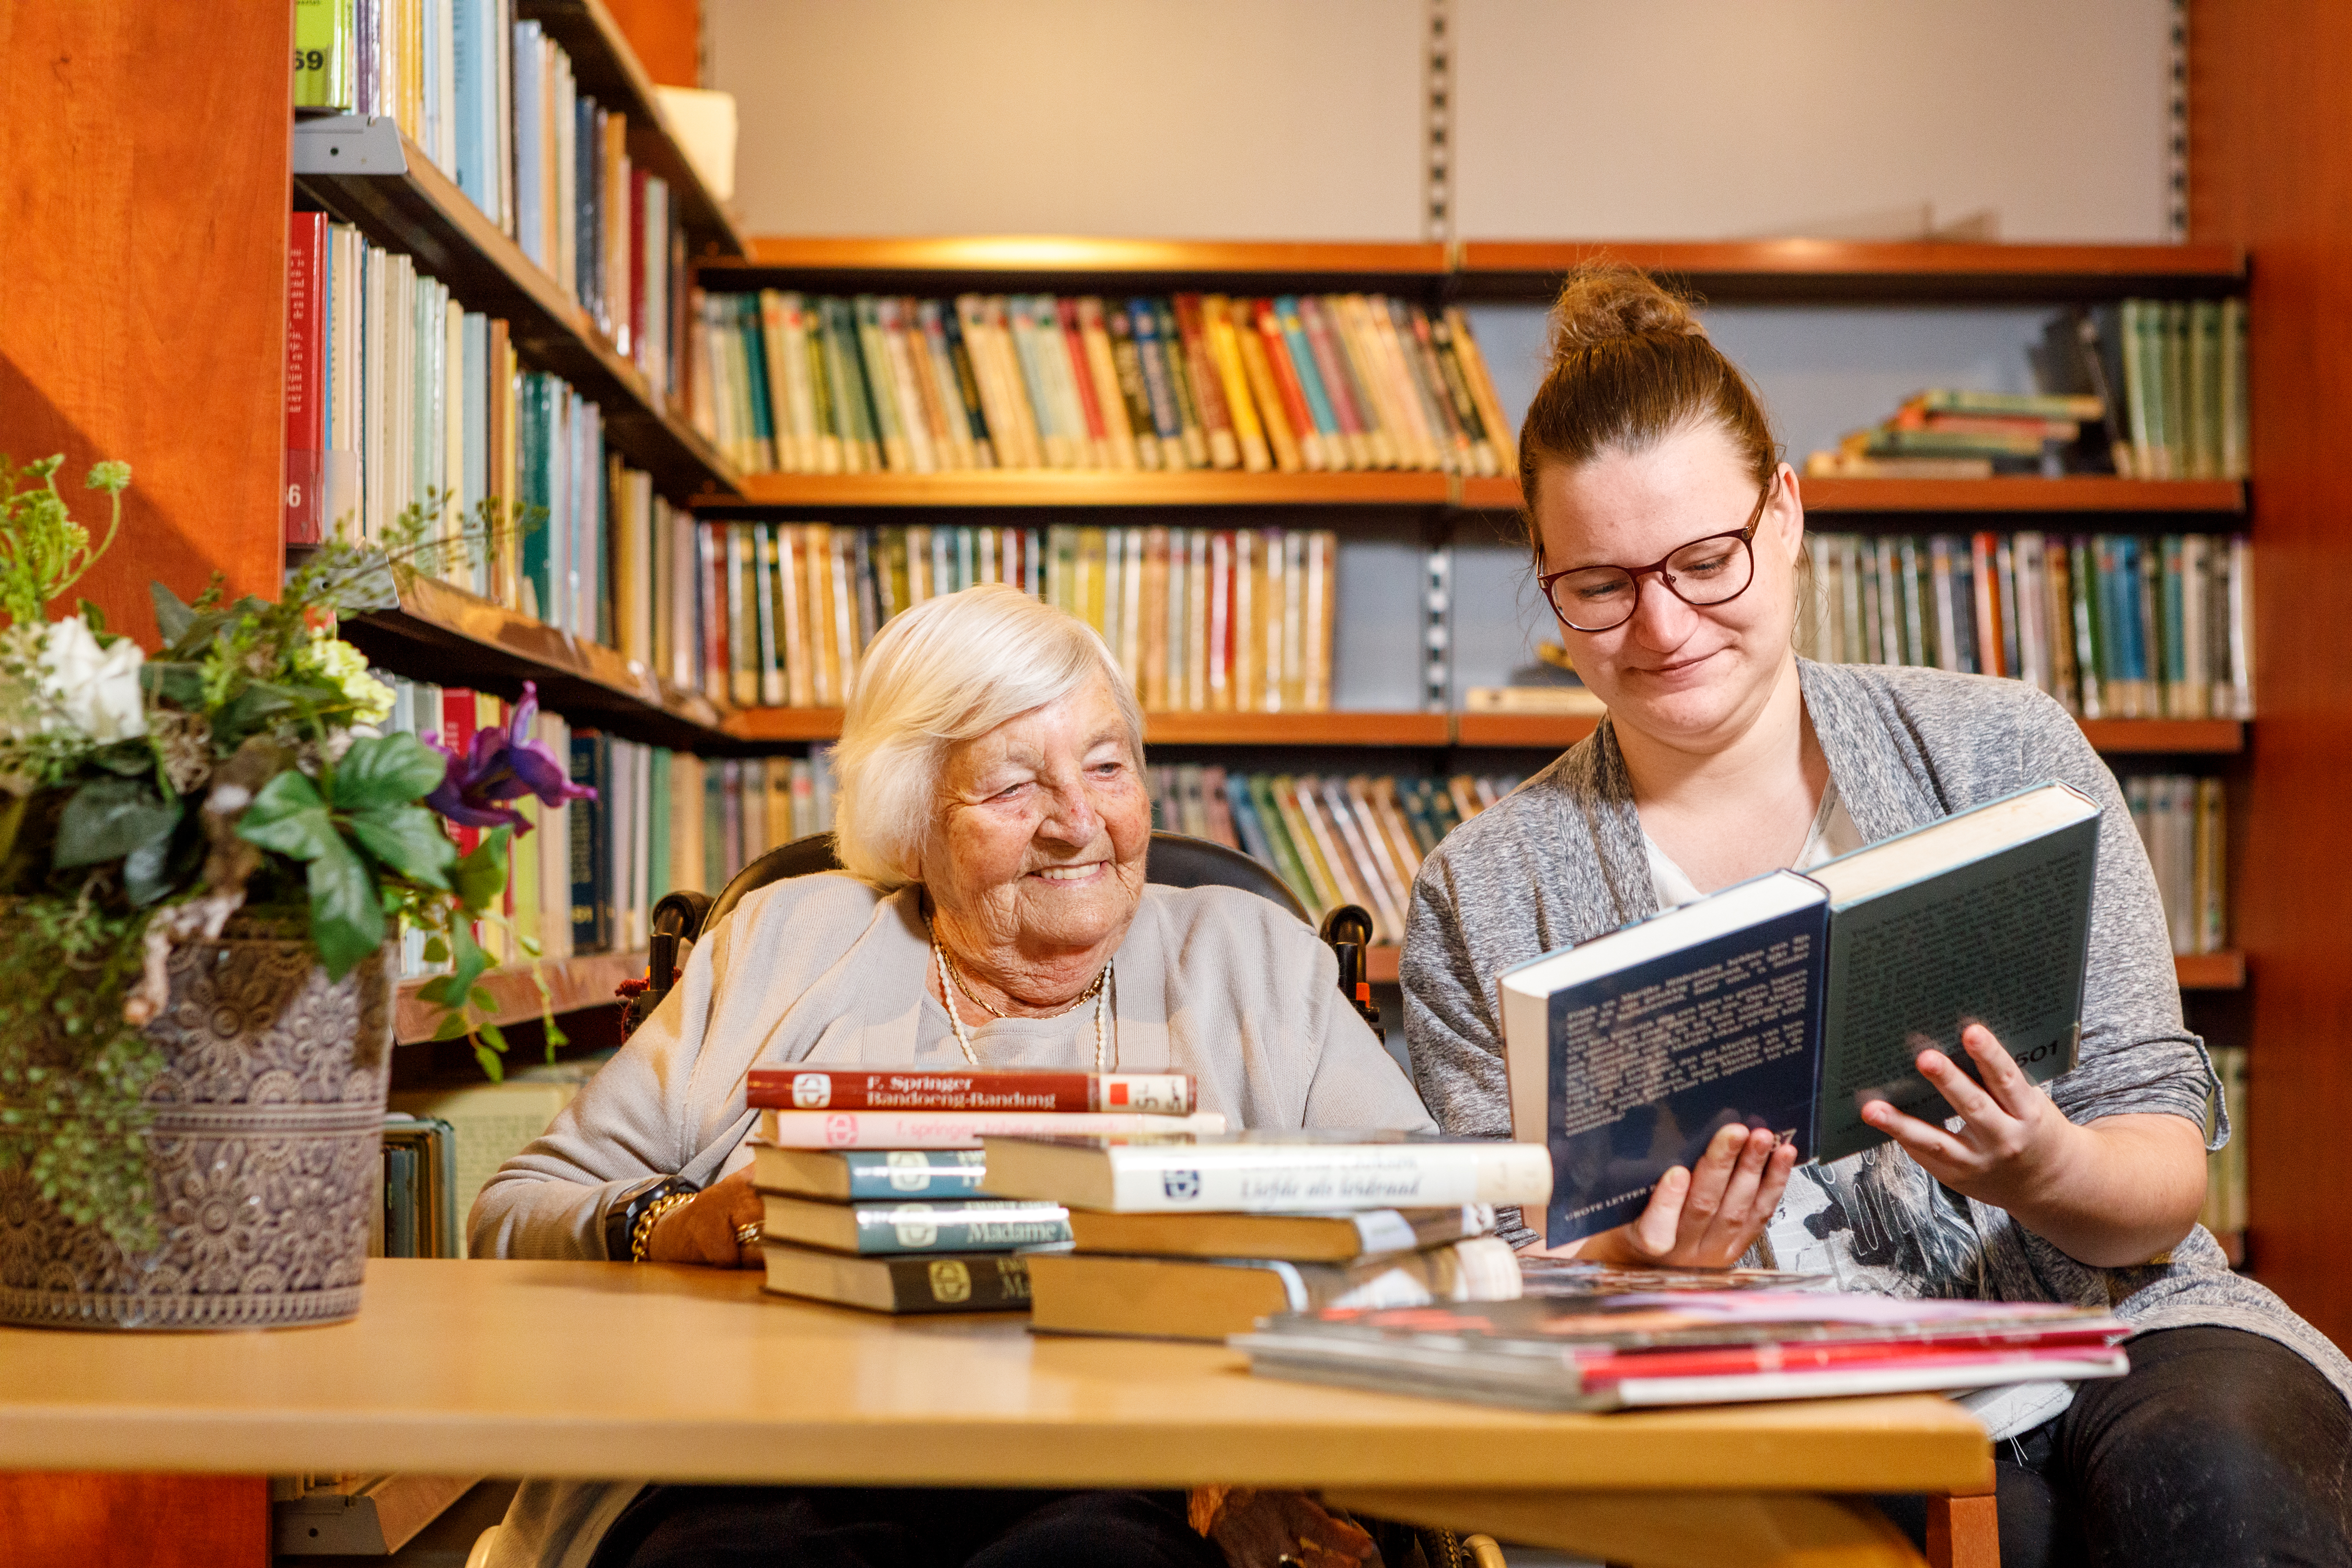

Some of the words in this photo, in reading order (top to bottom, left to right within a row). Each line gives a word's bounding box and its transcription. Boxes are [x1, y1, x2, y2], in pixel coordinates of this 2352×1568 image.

[867, 1075, 884, 1091] F.
[889, 1075, 973, 1093] Springer
[867, 1091, 1056, 1110] Bandoeng-Bandung
[967, 1221, 1057, 1243] Madame
